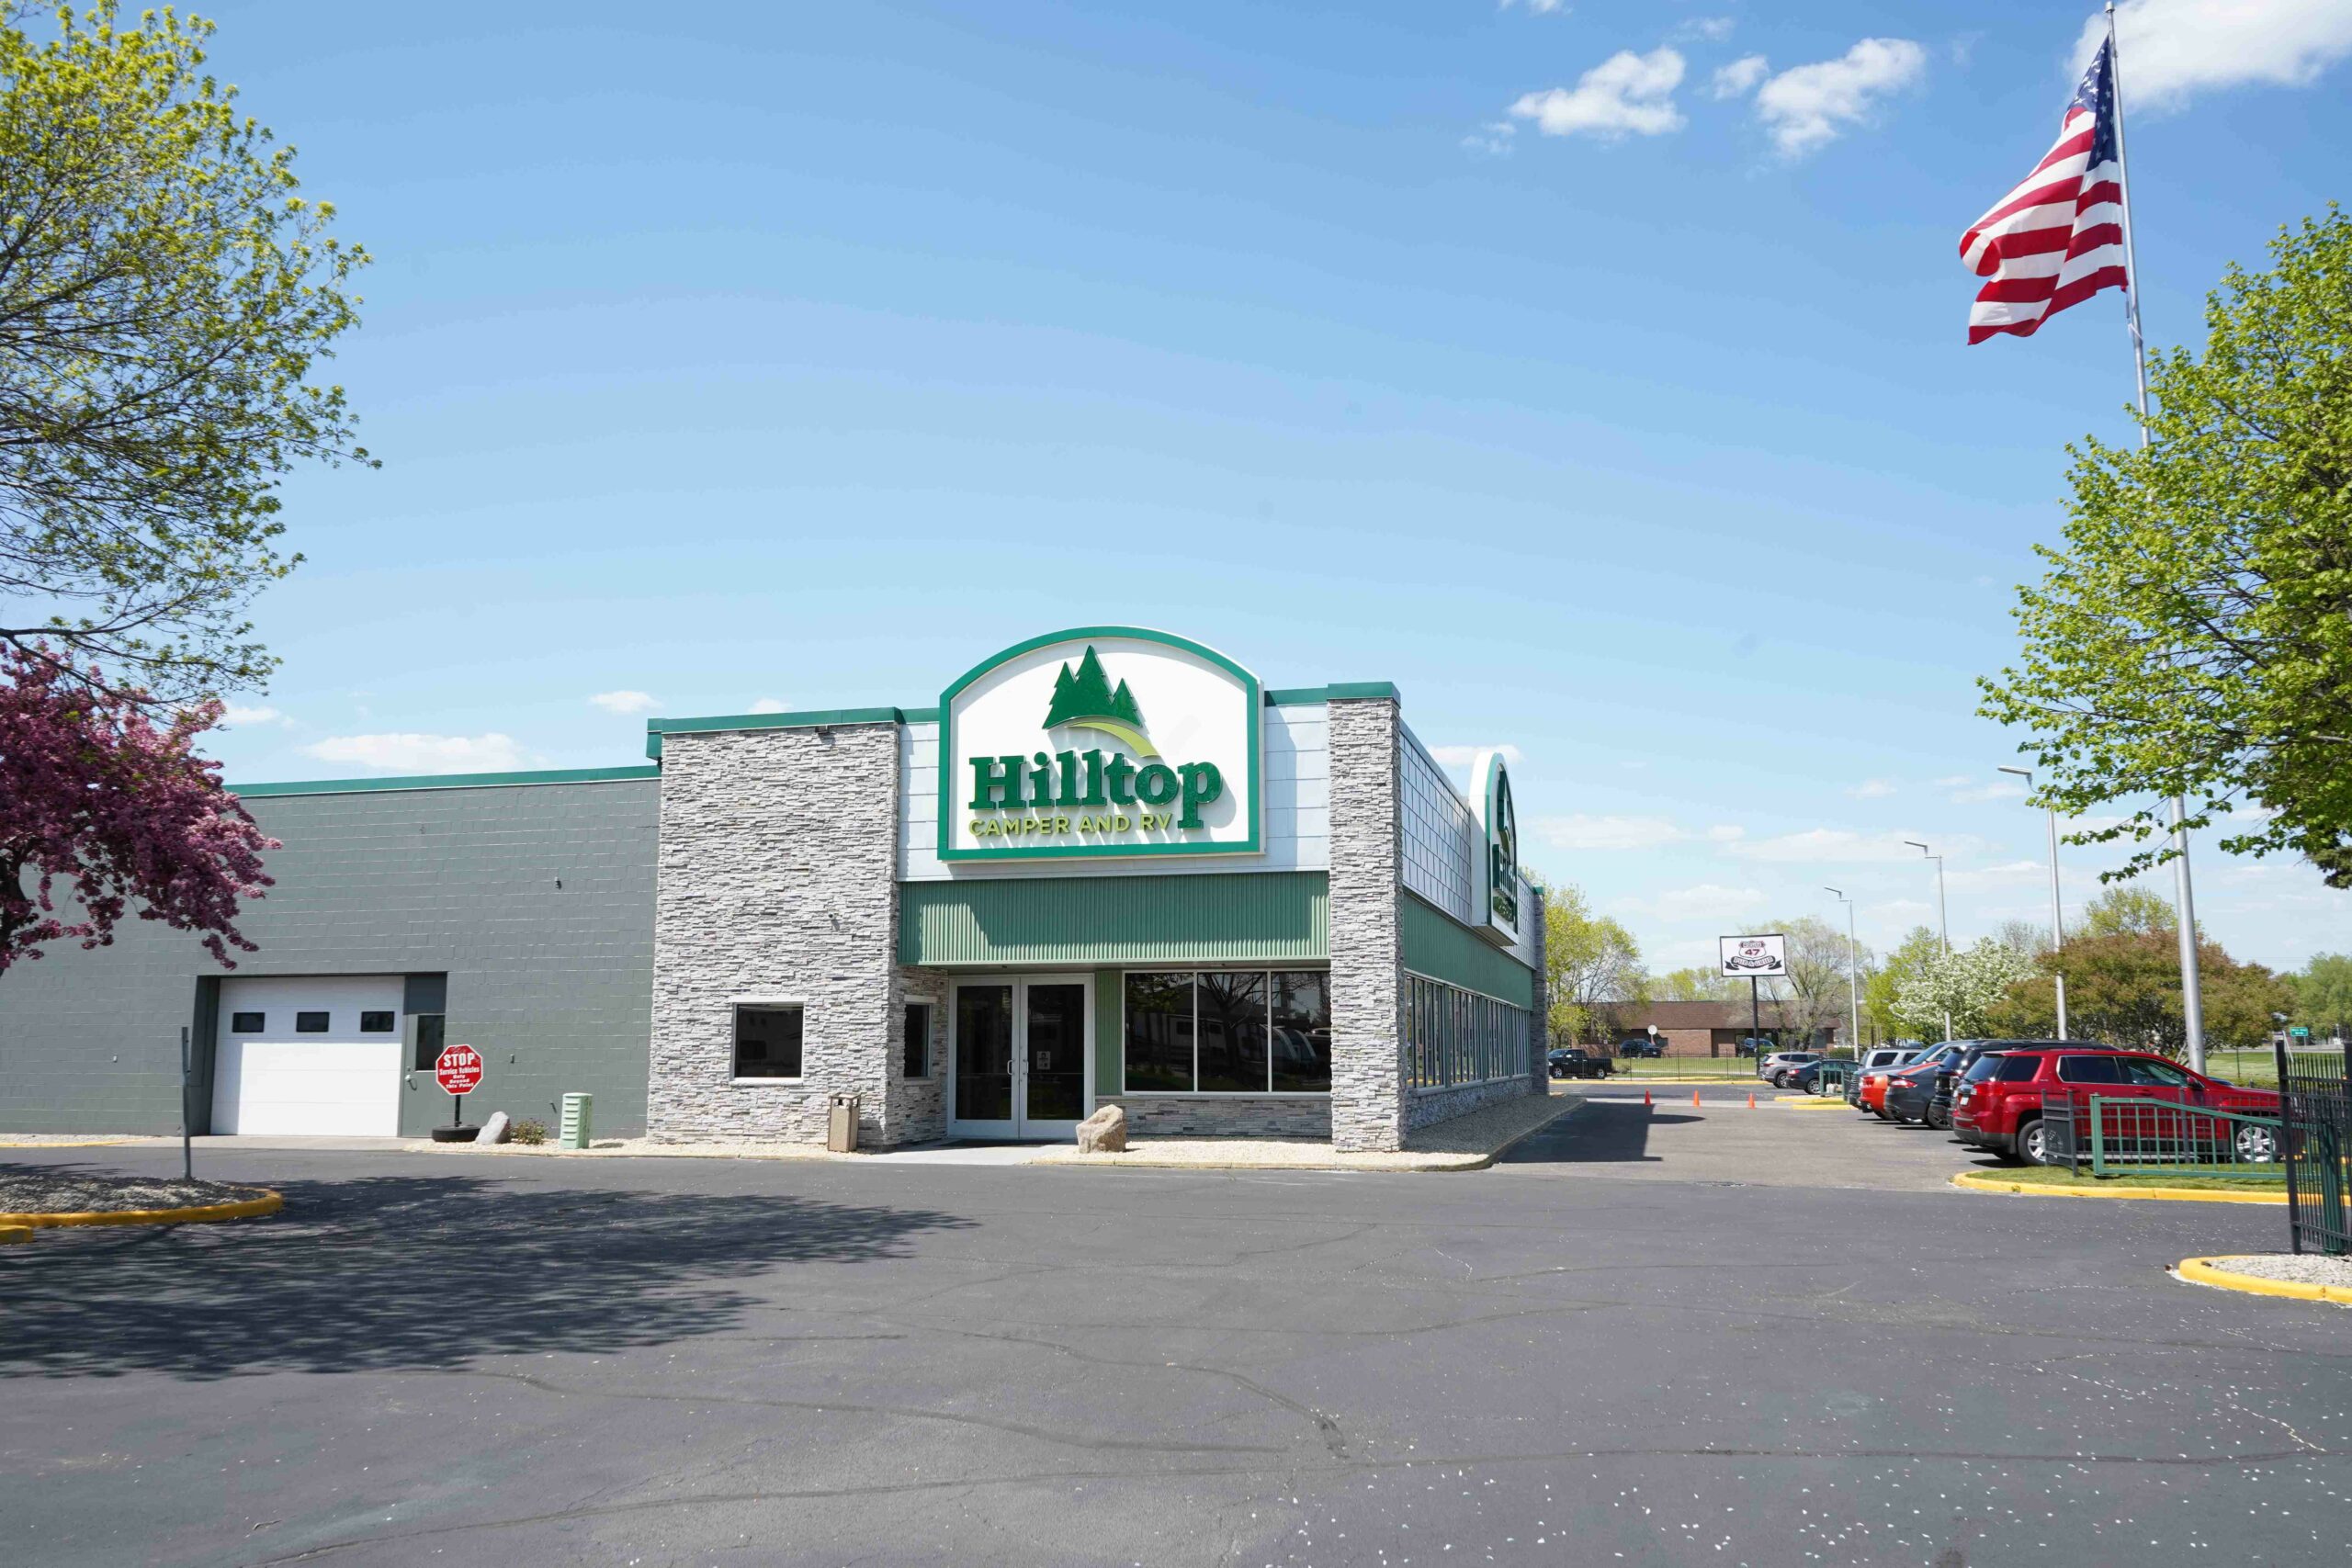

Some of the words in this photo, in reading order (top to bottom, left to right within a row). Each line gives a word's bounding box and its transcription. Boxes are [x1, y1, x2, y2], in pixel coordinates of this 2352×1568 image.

[968, 749, 1224, 829] Hilltop
[968, 816, 1070, 837] CAMPER
[1078, 814, 1132, 834] AND
[1139, 812, 1172, 831] RV
[444, 1053, 475, 1066] STOP
